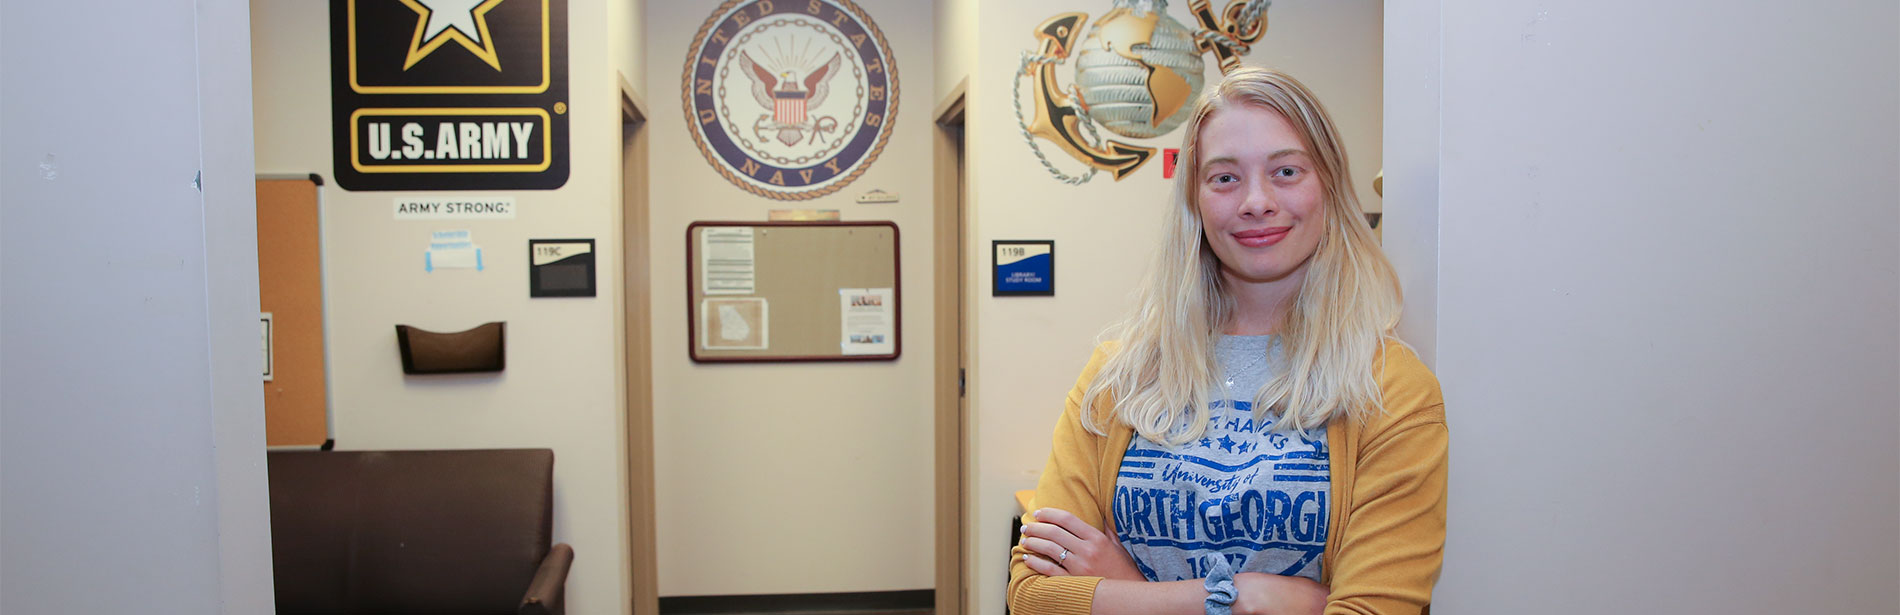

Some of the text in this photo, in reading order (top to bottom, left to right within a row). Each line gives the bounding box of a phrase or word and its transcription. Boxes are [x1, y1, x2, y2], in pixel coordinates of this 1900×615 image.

[697, 0, 885, 128] UNITED STATES
[740, 157, 841, 186] NAVY
[398, 202, 440, 214] ARMY
[536, 246, 561, 256] 119C
[1002, 247, 1025, 257] 119B
[1162, 462, 1260, 494] University of
[1199, 489, 1330, 543] GEORGI
